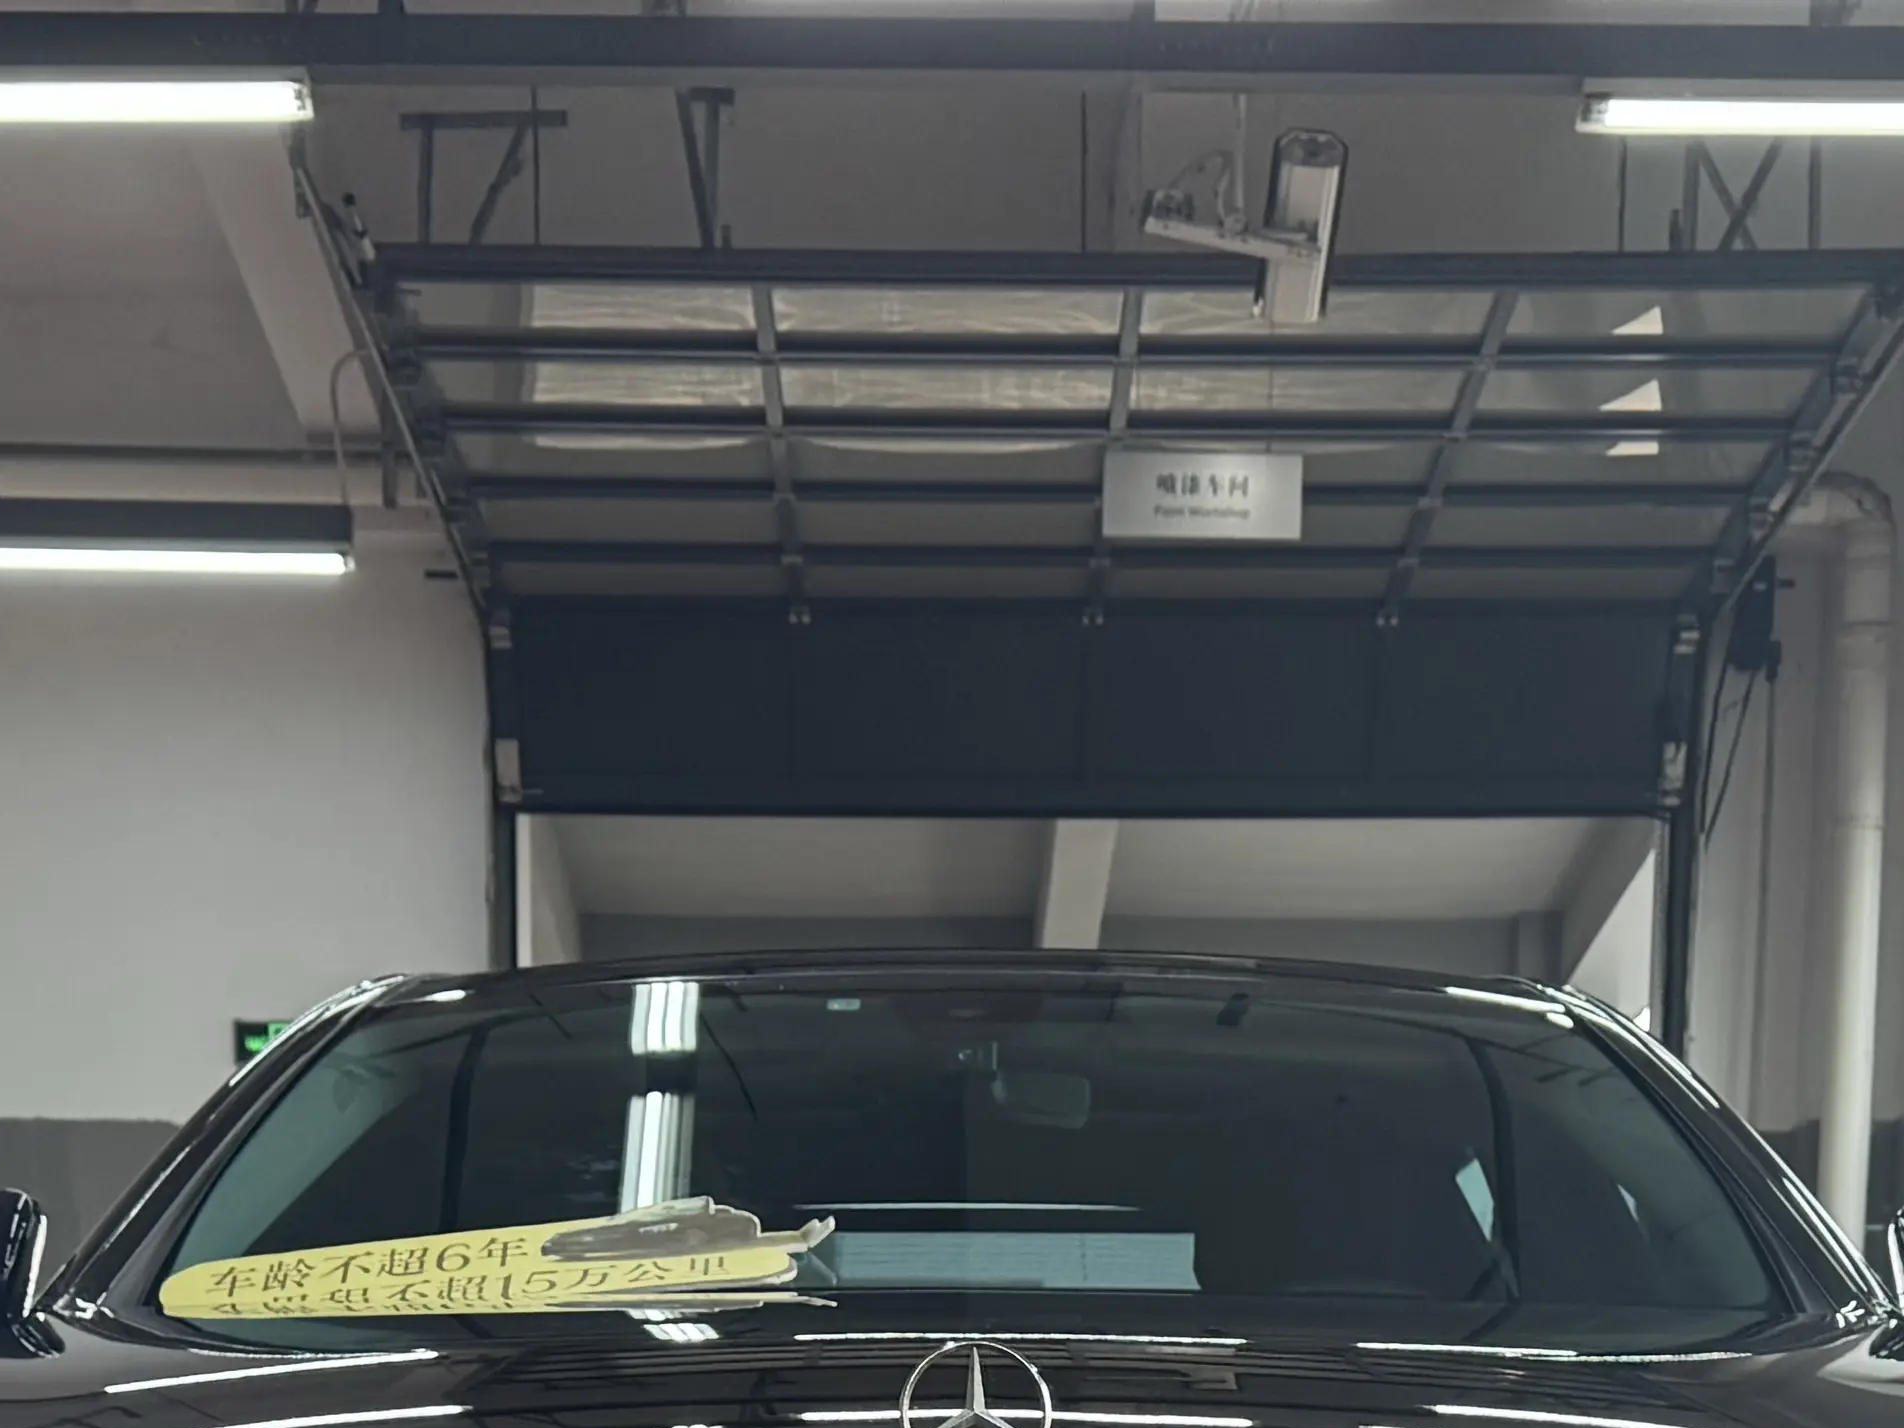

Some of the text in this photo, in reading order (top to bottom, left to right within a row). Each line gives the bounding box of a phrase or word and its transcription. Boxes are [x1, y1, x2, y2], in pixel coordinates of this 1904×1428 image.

[206, 1236, 529, 1298] 车龄不超6年
